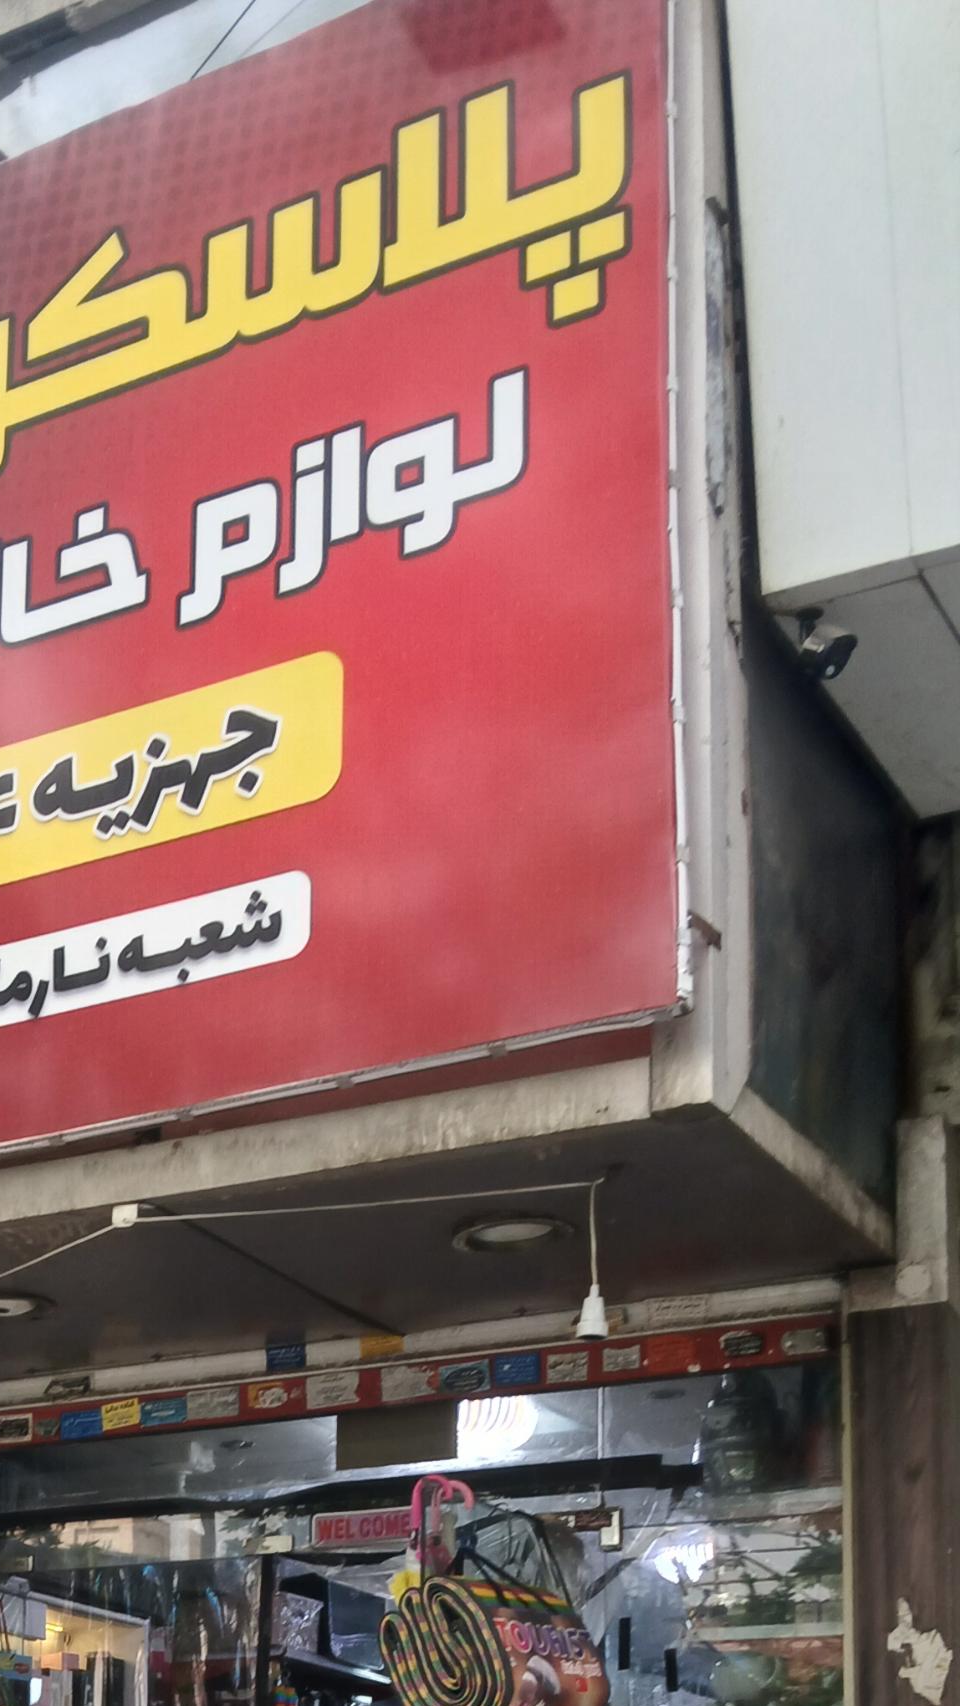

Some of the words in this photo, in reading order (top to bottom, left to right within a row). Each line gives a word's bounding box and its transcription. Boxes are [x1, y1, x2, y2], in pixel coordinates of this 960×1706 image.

[179, 368, 527, 626] لوازم
[117, 889, 283, 983] شعبه
[318, 1513, 411, 1541] WELCOME
[492, 1616, 592, 1660] TOURIST
